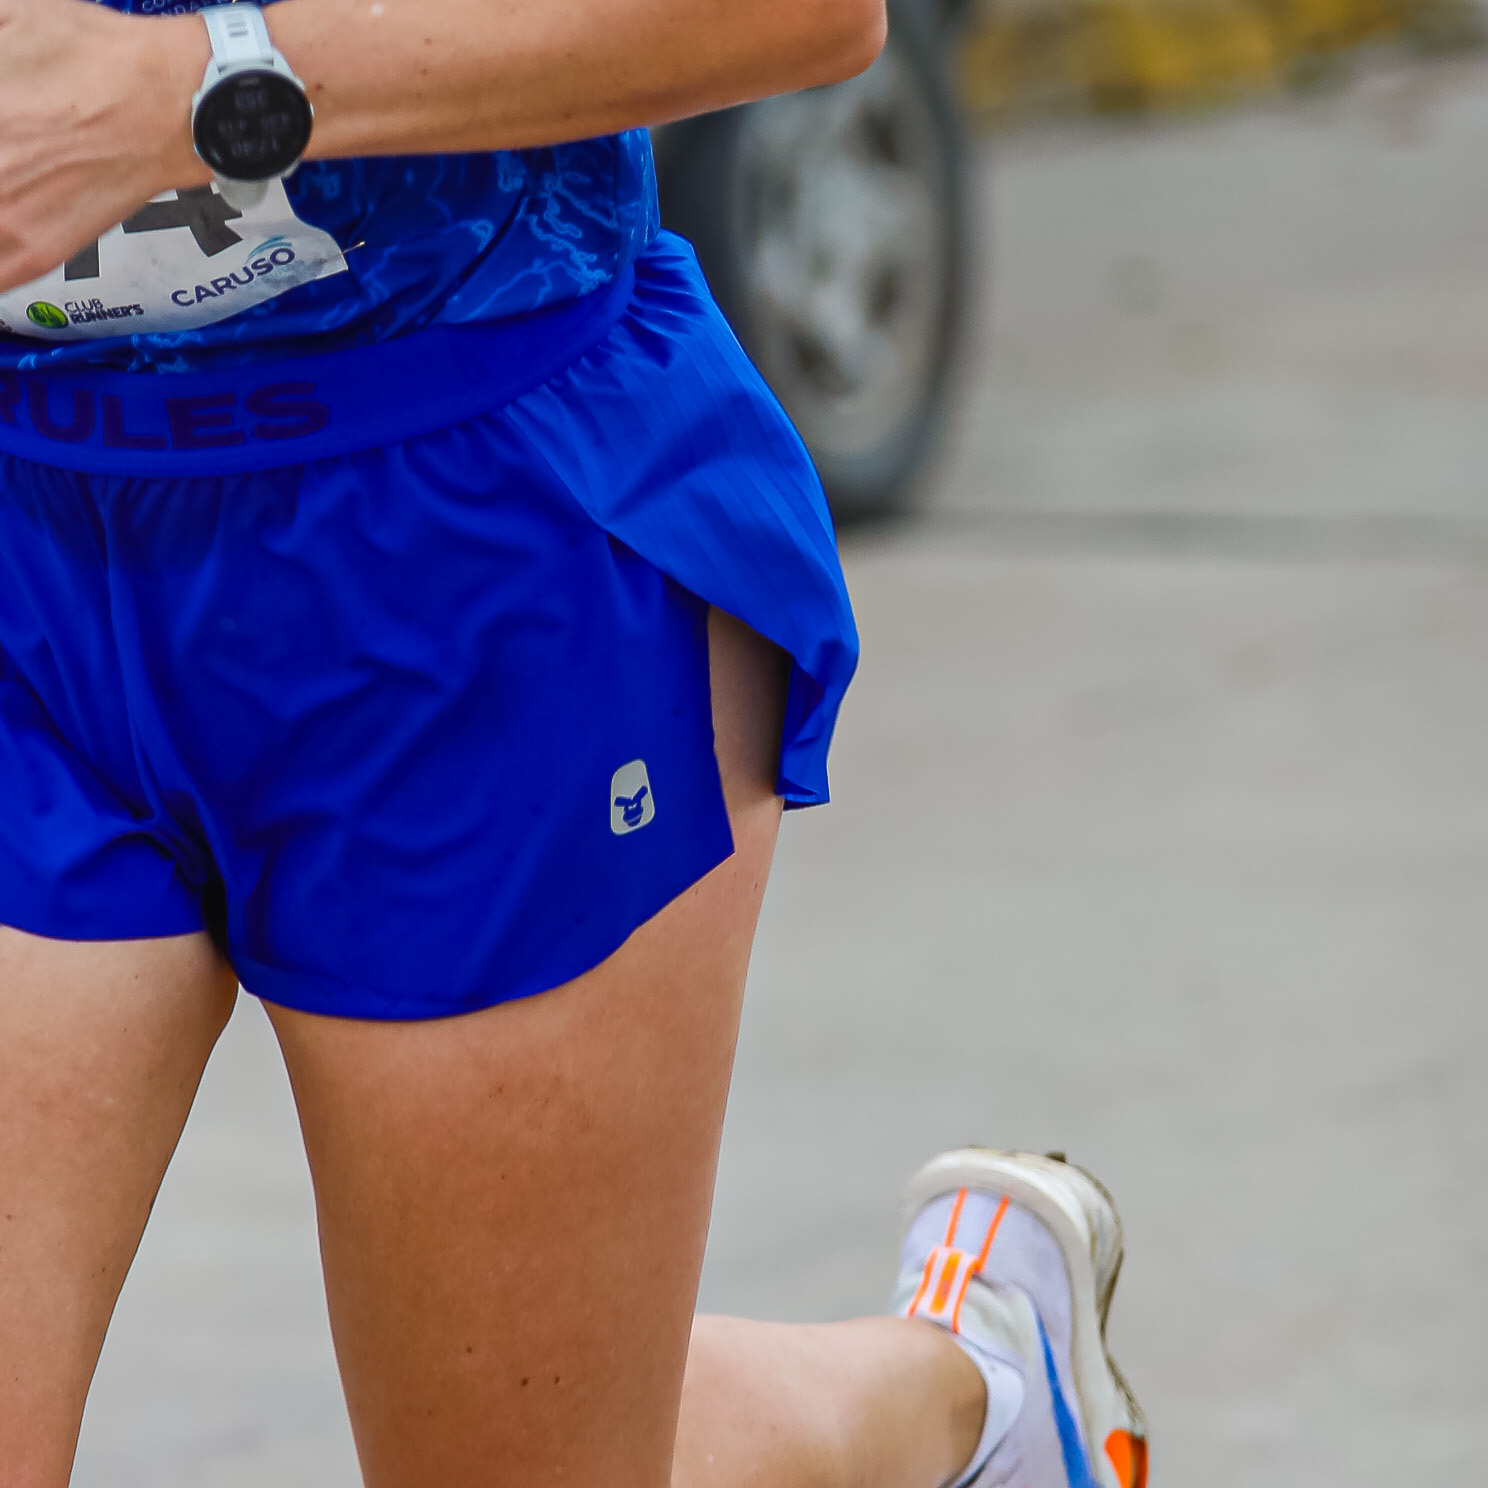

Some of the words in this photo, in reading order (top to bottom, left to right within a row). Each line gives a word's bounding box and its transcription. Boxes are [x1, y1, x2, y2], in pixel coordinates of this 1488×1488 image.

[170, 246, 296, 308] CARUSO
[64, 298, 104, 313] CLUB
[72, 303, 145, 325] RUNNER'S
